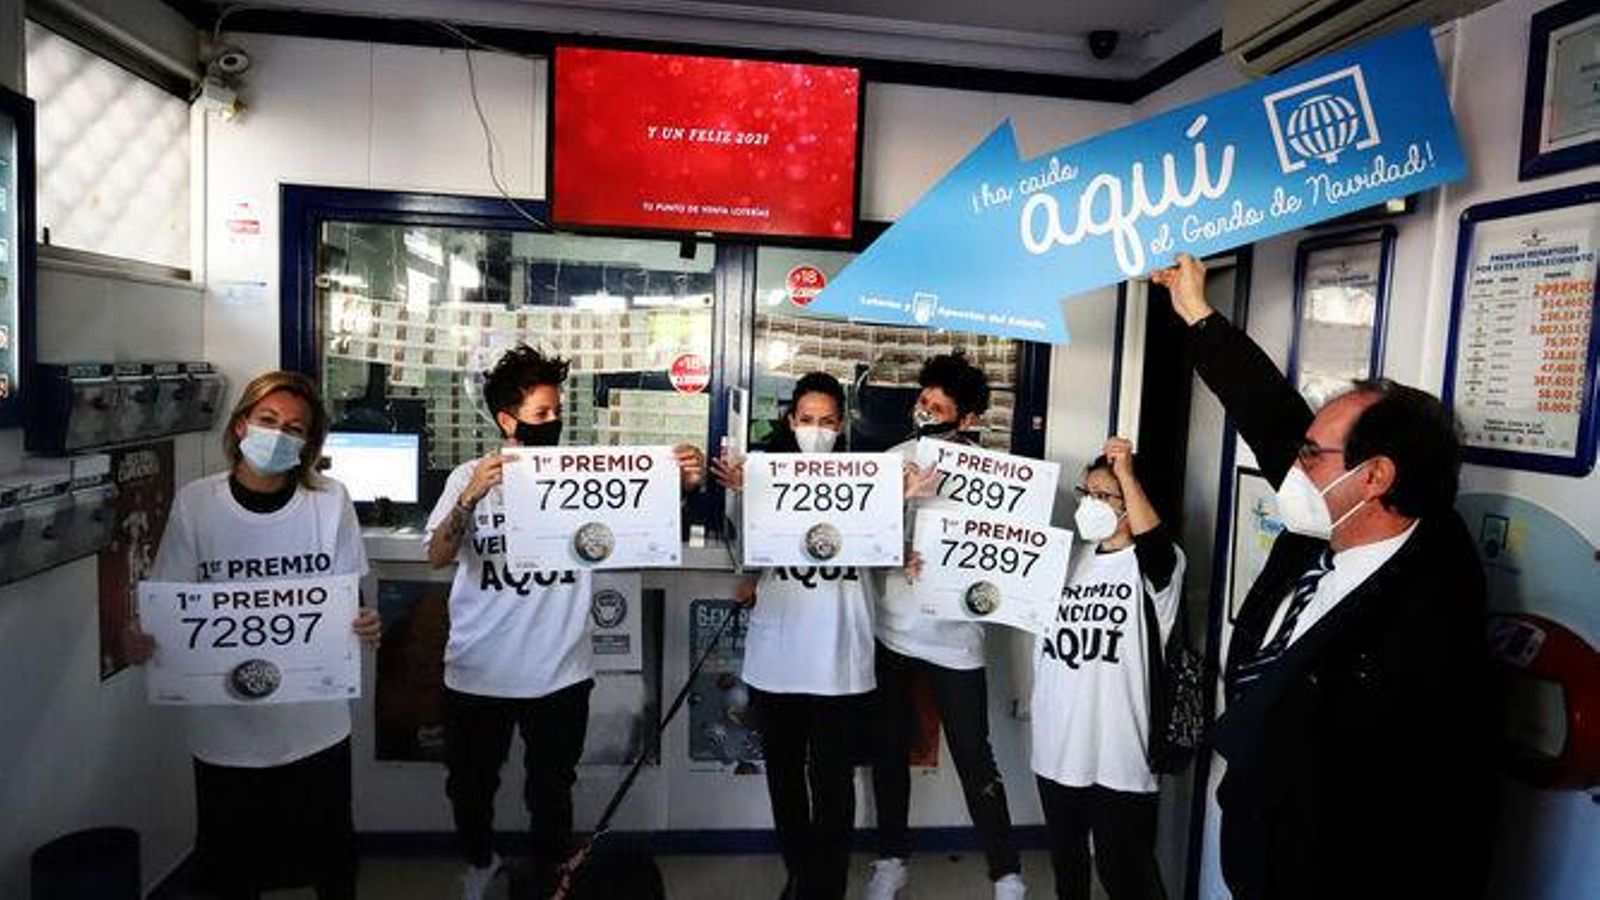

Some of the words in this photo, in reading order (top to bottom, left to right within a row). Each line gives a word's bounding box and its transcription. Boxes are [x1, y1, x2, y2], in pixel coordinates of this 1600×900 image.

[662, 127, 685, 140] UN
[689, 128, 733, 143] FELIZ
[735, 132, 770, 145] 2021
[1019, 114, 1235, 276] aquí
[1151, 225, 1174, 254] el
[1183, 200, 1265, 243] Gordo
[1270, 187, 1302, 217] de
[1306, 141, 1436, 205] Navidad!
[560, 454, 653, 473] PREMIO
[794, 460, 879, 477] PREMIO
[956, 452, 1034, 482] PREMIO
[536, 478, 650, 511] 72897
[772, 483, 875, 512] 72897
[936, 469, 1026, 514] 72897
[964, 520, 1048, 548] PREMIO
[228, 553, 331, 579] PREMIO
[940, 540, 1041, 578] 72897
[213, 586, 328, 610] PREMIO
[181, 612, 323, 649] 72897
